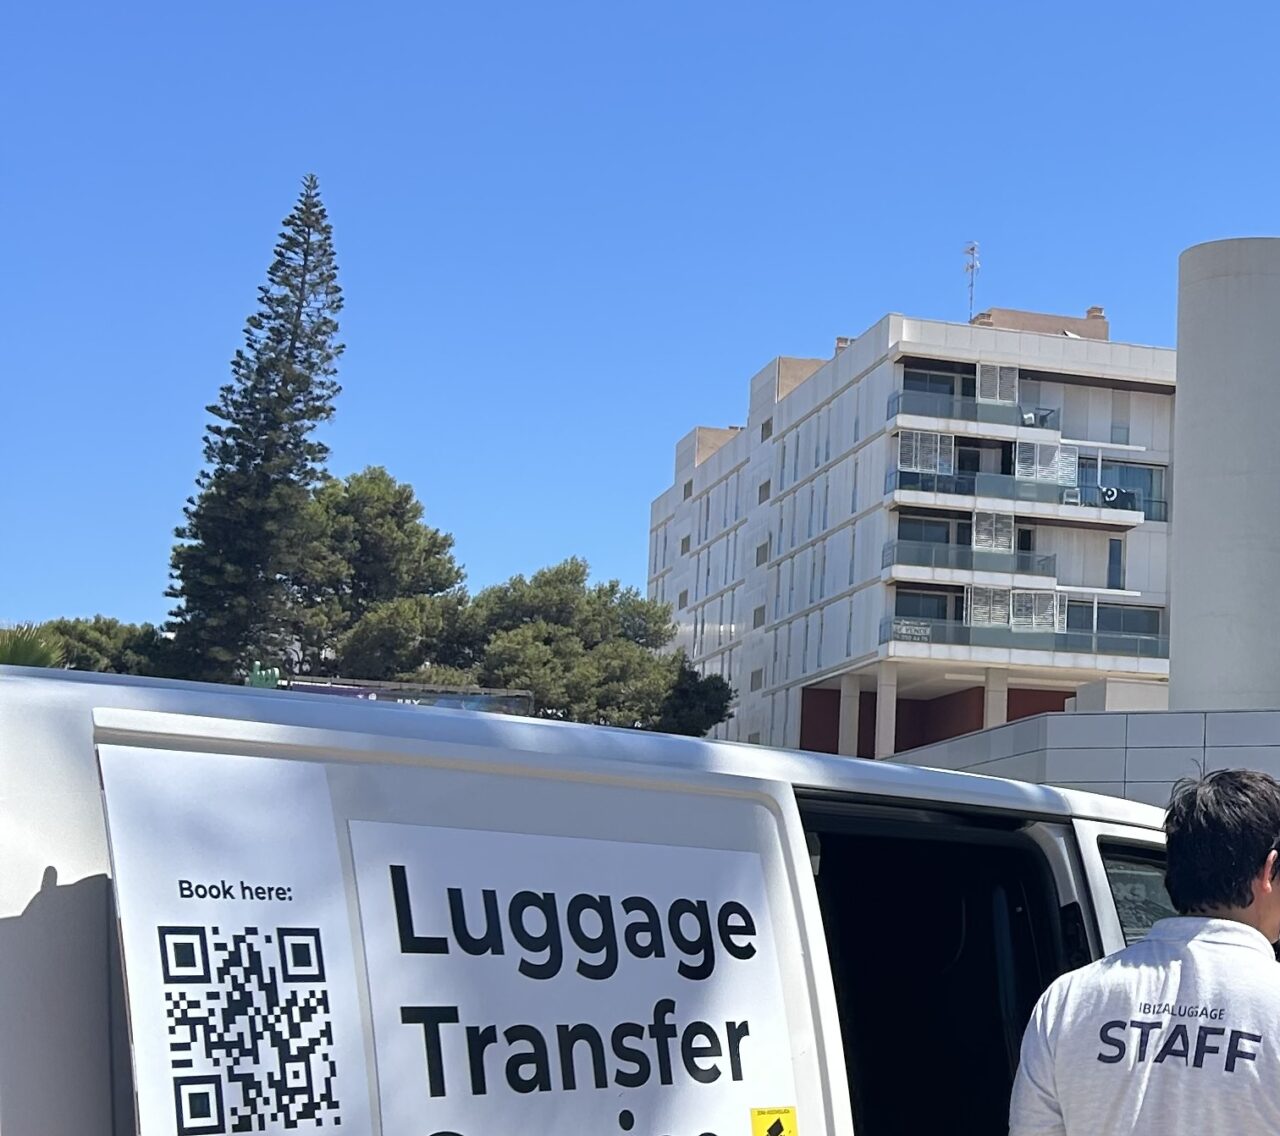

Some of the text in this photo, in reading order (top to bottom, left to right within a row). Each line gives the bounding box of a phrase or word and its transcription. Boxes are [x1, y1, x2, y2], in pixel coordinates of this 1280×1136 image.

[178, 879, 293, 902] Book here:
[389, 864, 758, 981] Luggage
[400, 998, 750, 1098] Transfer
[1097, 1019, 1263, 1073] STAFF
